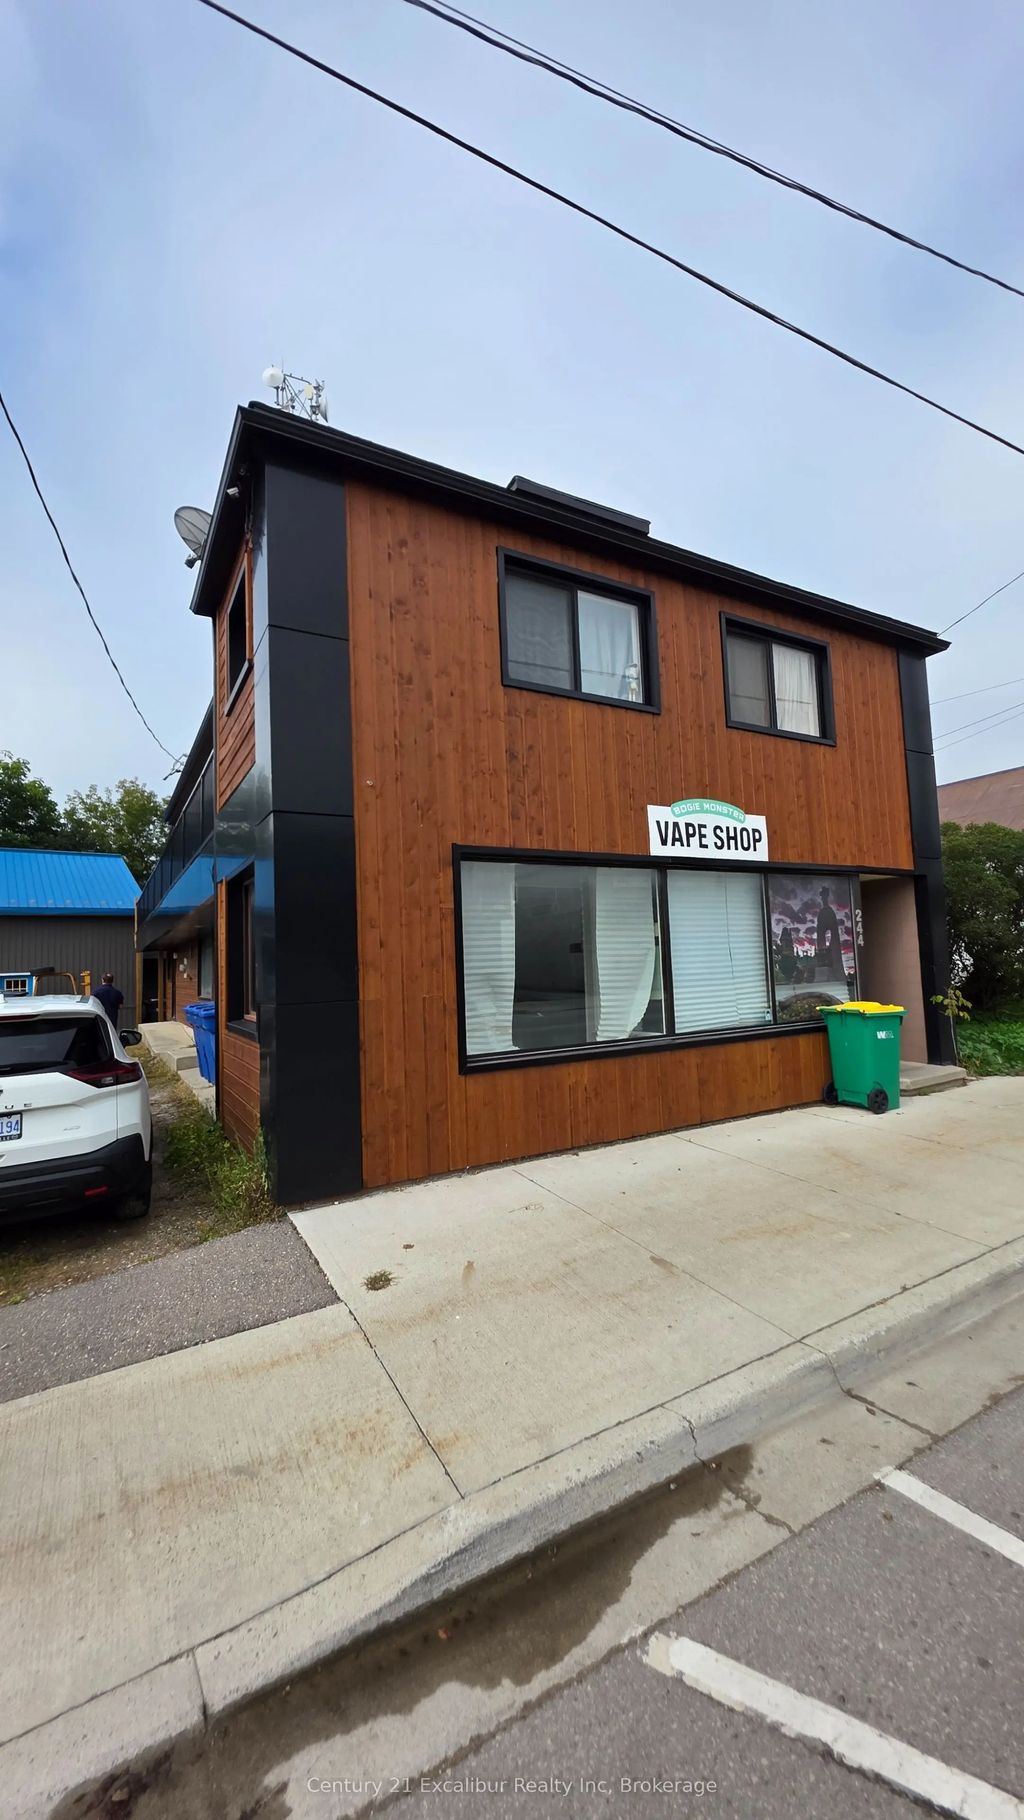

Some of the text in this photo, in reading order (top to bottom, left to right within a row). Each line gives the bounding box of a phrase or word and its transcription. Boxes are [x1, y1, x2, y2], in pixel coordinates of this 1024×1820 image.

[673, 802, 745, 822] BOGIE MONSTER
[655, 820, 762, 852] VAPE SHOP
[855, 909, 864, 947] 244
